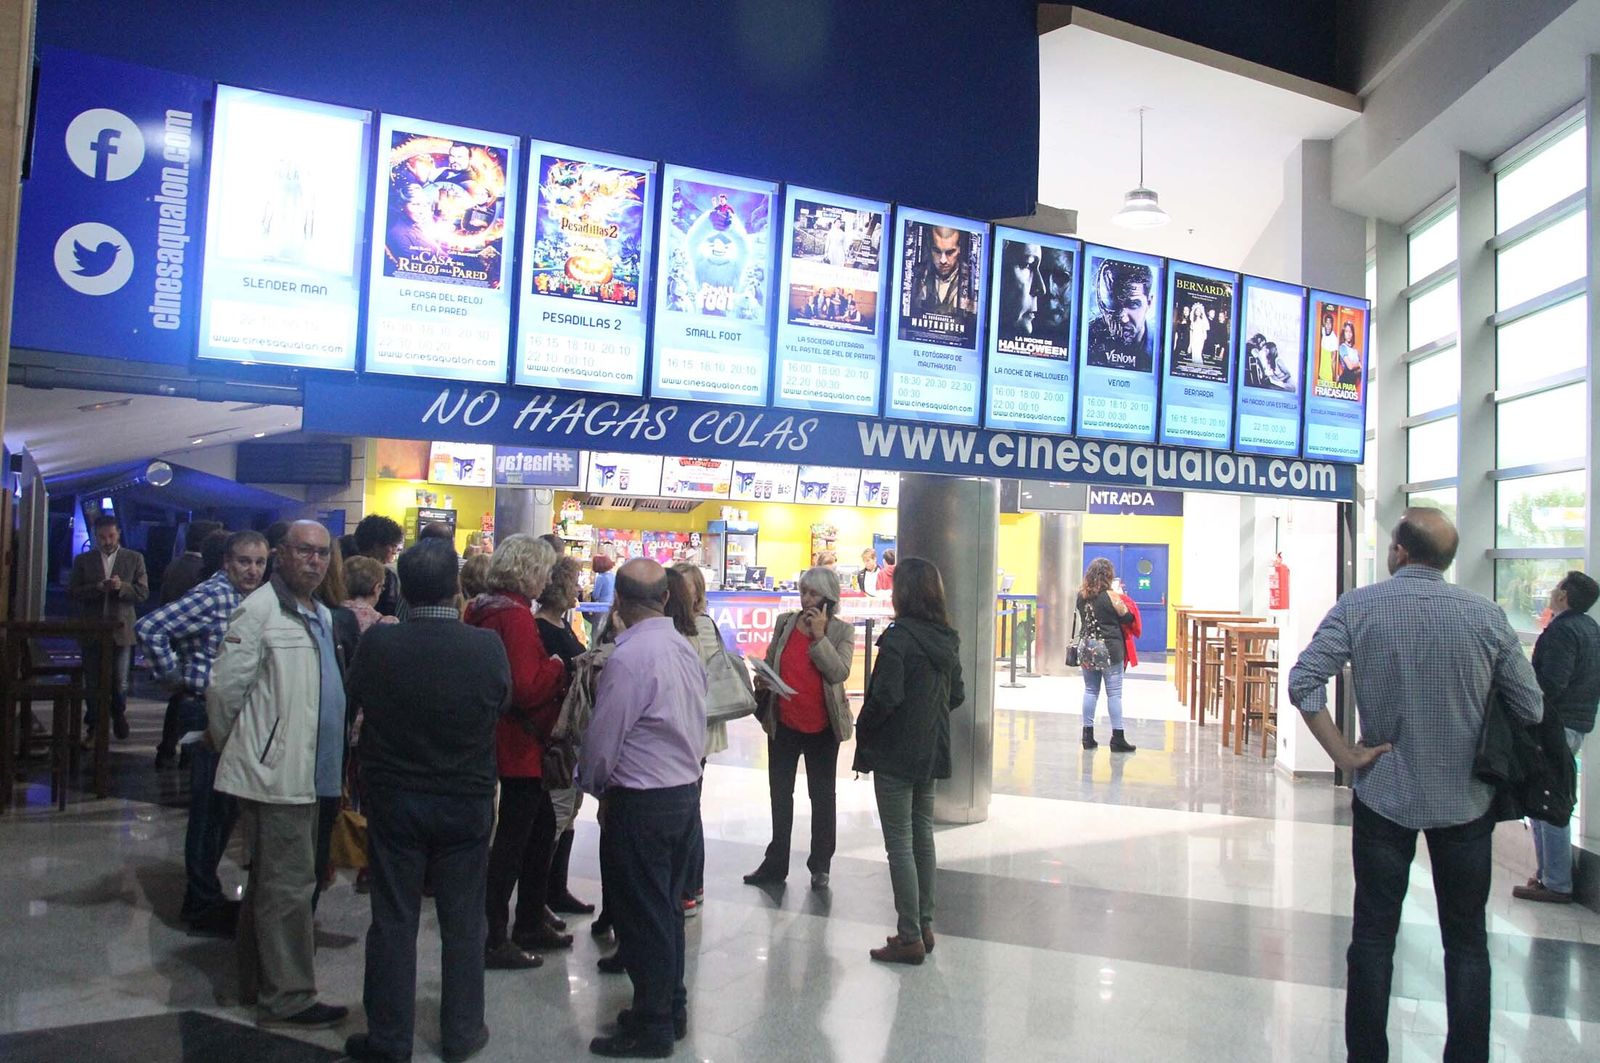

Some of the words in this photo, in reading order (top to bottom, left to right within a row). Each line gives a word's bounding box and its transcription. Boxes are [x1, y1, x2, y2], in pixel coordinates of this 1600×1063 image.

[149, 109, 193, 330] cinesaqualon.com
[561, 217, 609, 237] Pesadillas
[420, 251, 454, 266] CASA
[398, 257, 440, 275] RELOJ
[452, 266, 487, 280] PARED
[243, 277, 296, 292] SLENDER
[301, 283, 328, 296] MAN
[1176, 279, 1230, 298] BERNARDA
[400, 289, 411, 297] LA
[413, 290, 437, 300] CASA
[438, 293, 455, 302] DEL
[457, 295, 483, 305] RELOJ
[411, 303, 423, 312] EN
[425, 305, 436, 313] LA
[438, 306, 468, 317] PARED
[542, 311, 611, 329] PESADILLAS
[614, 319, 622, 330] 2
[912, 318, 965, 333] MAUTHAUSEN
[685, 327, 717, 340] SMALL
[719, 331, 742, 342] FOOT
[806, 337, 835, 347] SOCIEDAD
[836, 340, 865, 349] LITERARIA
[998, 339, 1068, 357] HALLOWEEN
[800, 346, 821, 355] PASTEL
[832, 350, 844, 358] PIEL
[845, 351, 853, 359] DE
[853, 352, 875, 361] PATATA
[1105, 349, 1136, 367] VENOM
[526, 363, 633, 380] www.cinesaqualon.com
[917, 361, 957, 371] MAUTHAUSEN
[1004, 368, 1023, 377] NOCHE
[1025, 370, 1032, 378] DE
[1034, 371, 1069, 381] HALLOWEEN
[661, 376, 759, 392] www.cinesaqualon.com
[1108, 378, 1131, 388] VENOM
[783, 388, 871, 402] www.cinesaqualon.com
[1184, 387, 1214, 398] BERNARDA
[1314, 386, 1359, 401] FRACASADOS
[893, 399, 973, 413] www.cinesaqualon.com
[422, 388, 500, 427] NO
[513, 394, 678, 441] HAGAS
[688, 409, 819, 452] COLAS
[993, 410, 1066, 422] www.cinesaqualon.com
[1083, 420, 1150, 431] www.cinesaqualon.com
[858, 420, 1337, 492] www.cinesaqualon.com
[753, 570, 760, 580] 4
